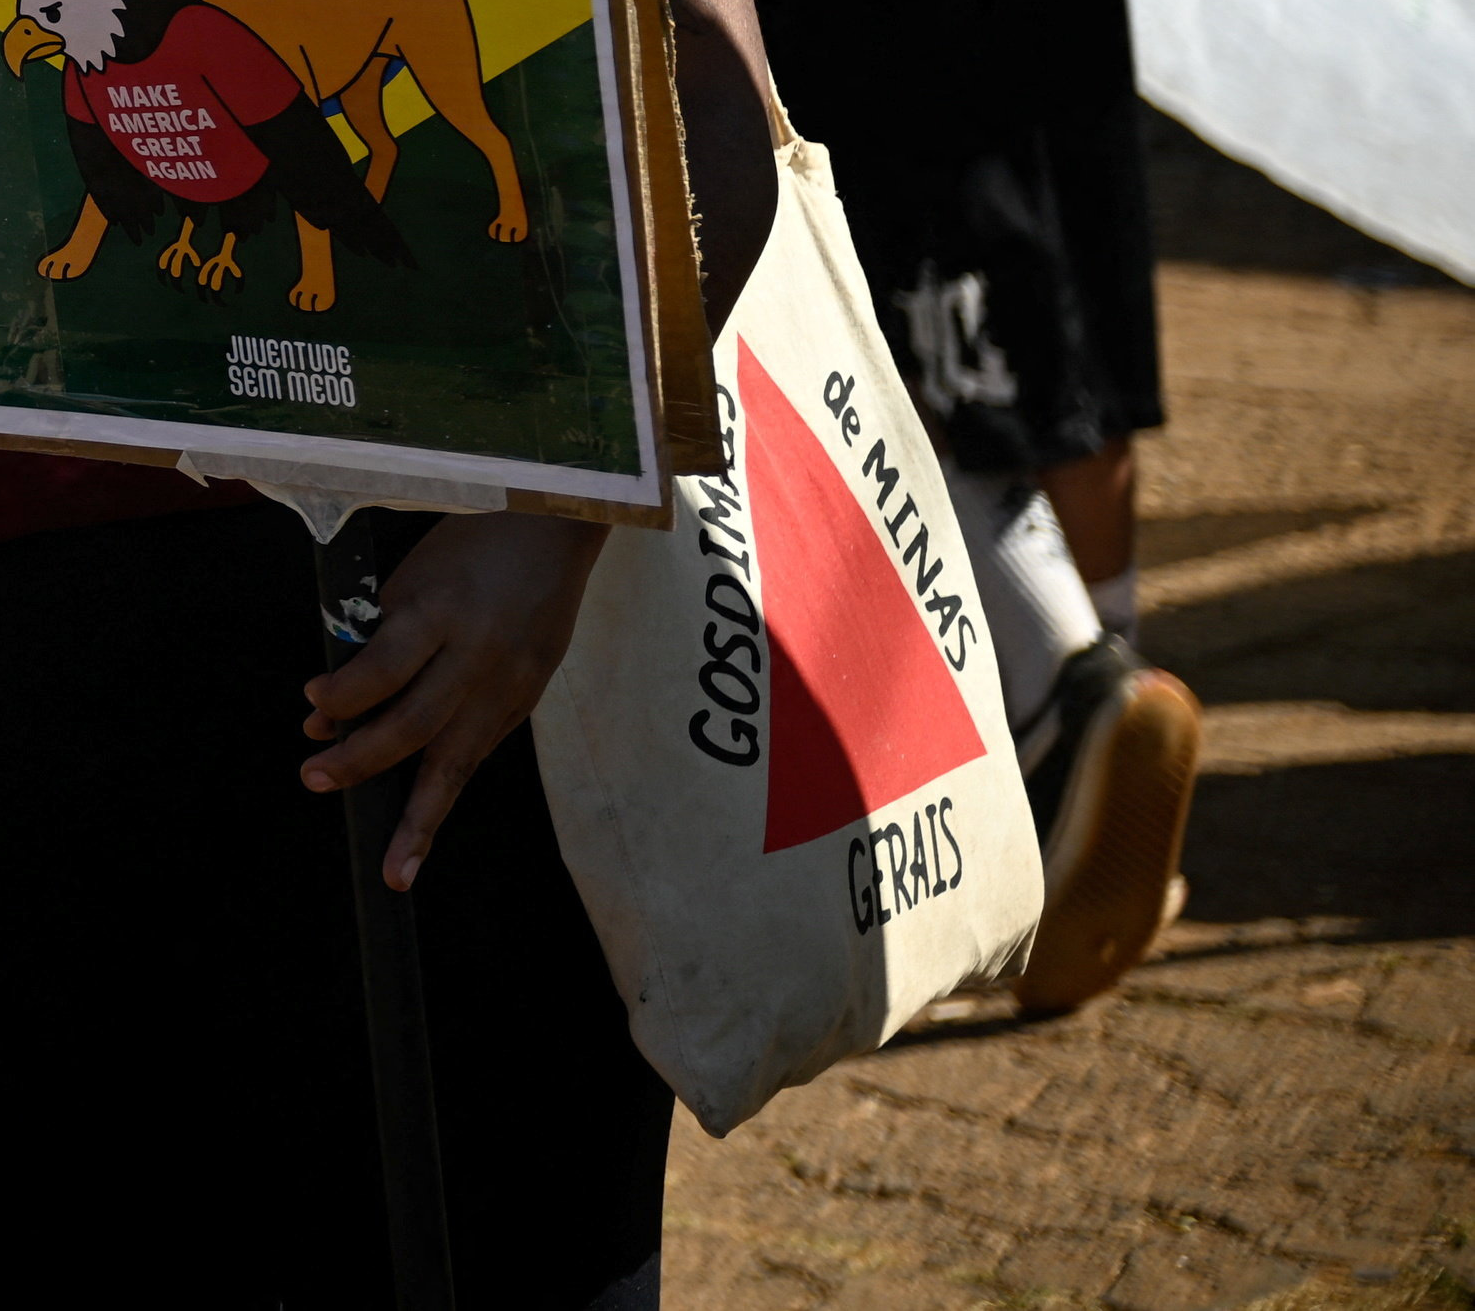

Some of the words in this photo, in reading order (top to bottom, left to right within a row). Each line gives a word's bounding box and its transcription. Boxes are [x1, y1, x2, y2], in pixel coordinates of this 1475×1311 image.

[107, 83, 183, 109] MAKE
[108, 108, 217, 134] AMERICA
[131, 135, 204, 157] GREAT
[146, 160, 218, 180] AGAIN
[226, 335, 352, 375] JUVENTUDE
[228, 365, 282, 400] SEM
[287, 370, 357, 408] MEDO
[823, 370, 862, 448] de
[861, 438, 977, 672] MINAS
[847, 796, 964, 938] GERAIS
